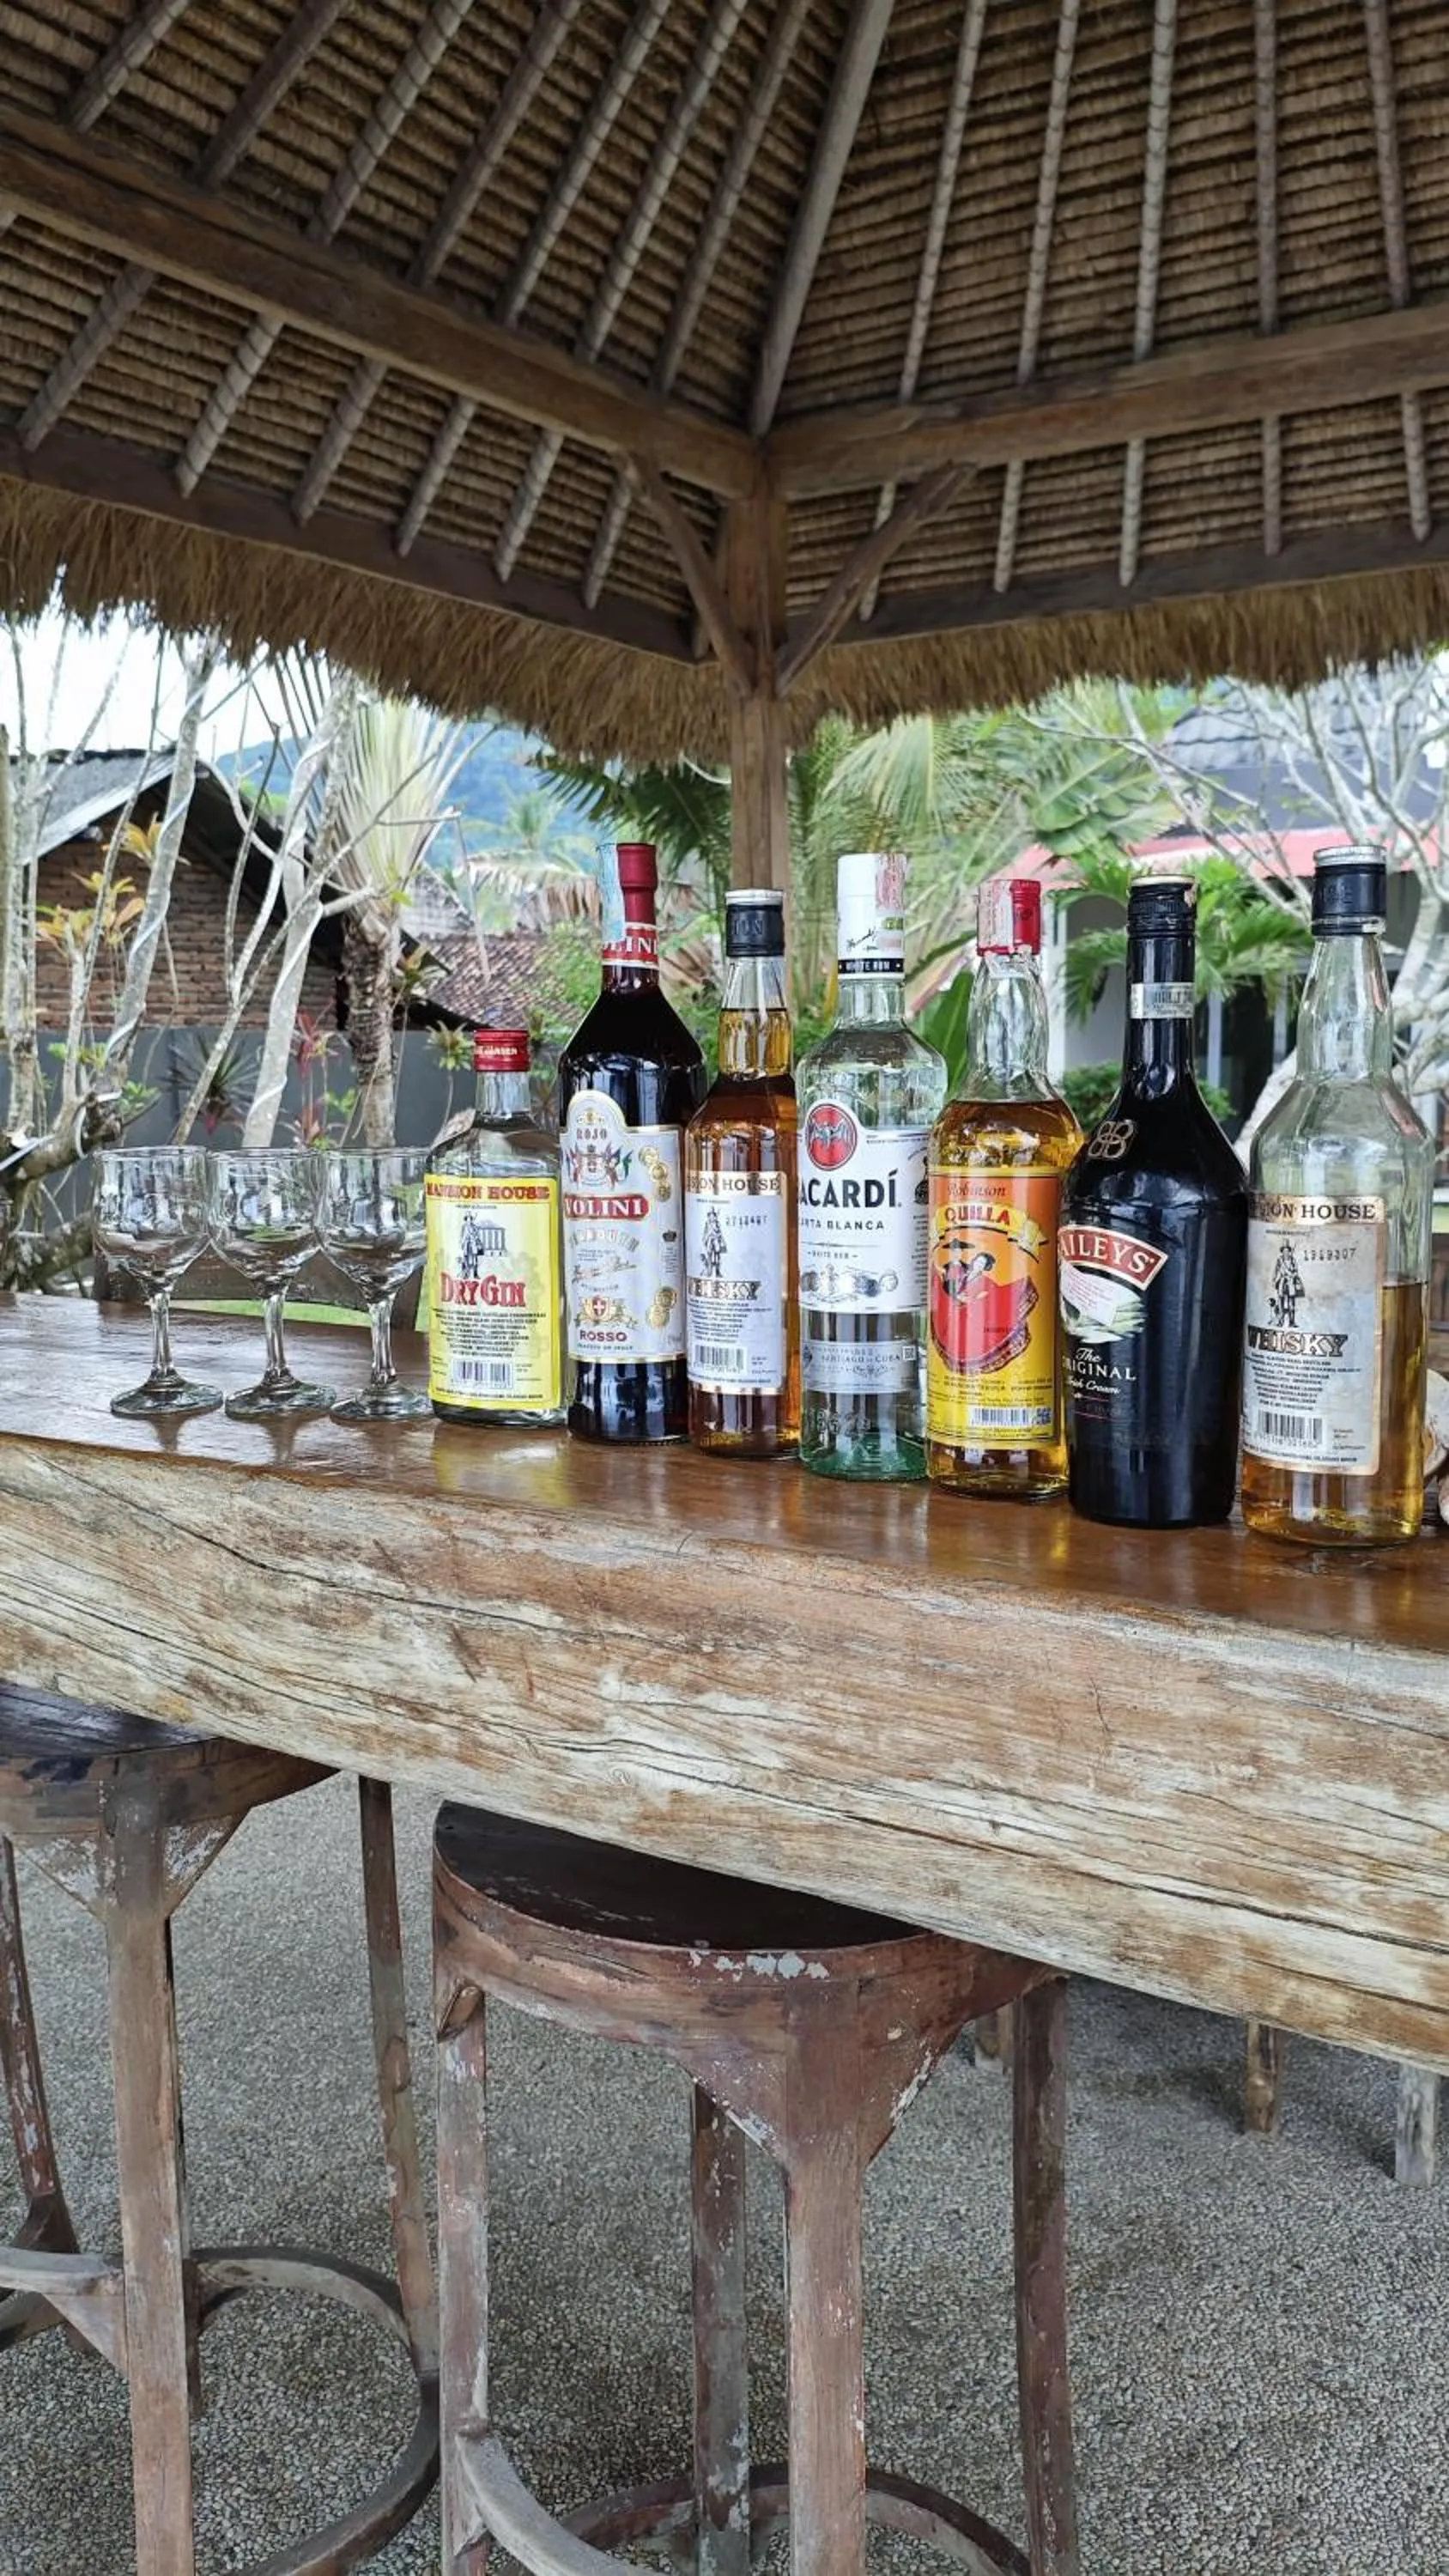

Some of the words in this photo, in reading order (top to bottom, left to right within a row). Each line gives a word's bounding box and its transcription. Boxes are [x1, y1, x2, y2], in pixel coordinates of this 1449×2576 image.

[846, 960, 870, 971] WHITE
[873, 960, 890, 971] RUM
[722, 1178, 780, 1192] HOUSE
[947, 1180, 1007, 1197] Robinson
[488, 1186, 550, 1200] HOUSE
[945, 1205, 1010, 1226] QUILLA
[1300, 1204, 1375, 1220] HOUSE
[827, 1220, 884, 1230] BLANCA
[480, 1275, 526, 1307] GIN
[579, 1330, 627, 1341] ROSSO
[1076, 1347, 1101, 1363] The
[1086, 1381, 1121, 1394] Cream
